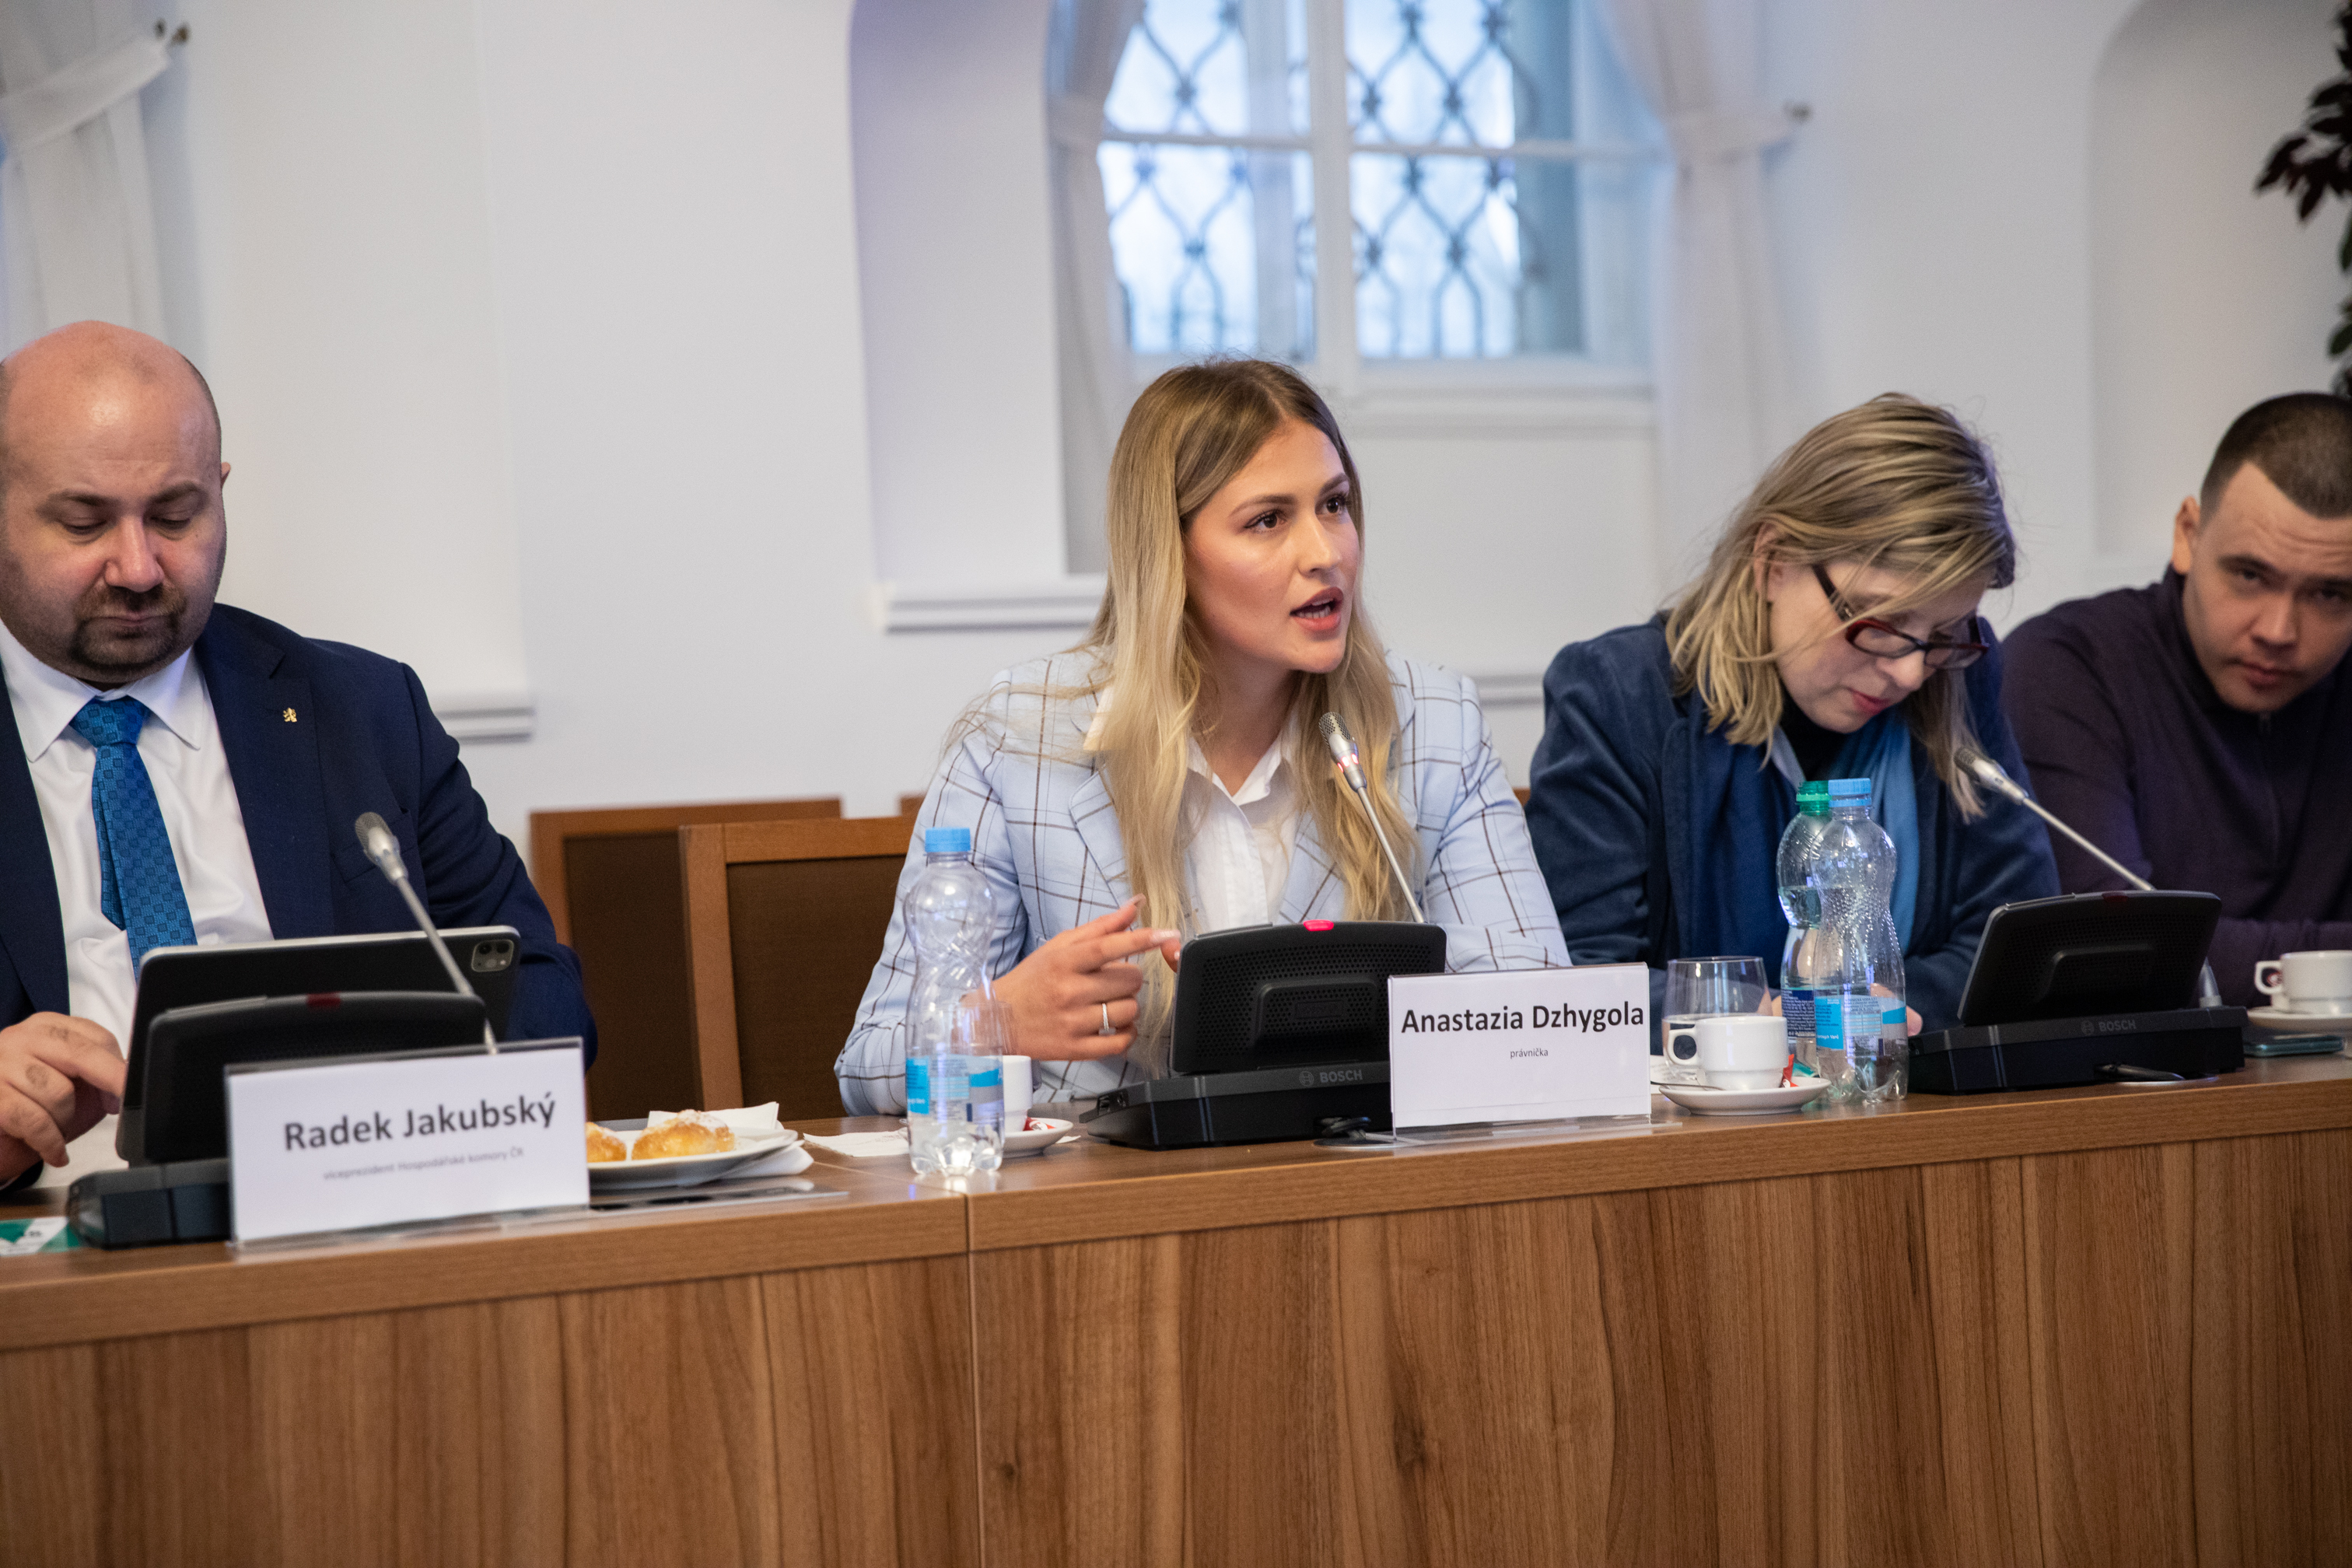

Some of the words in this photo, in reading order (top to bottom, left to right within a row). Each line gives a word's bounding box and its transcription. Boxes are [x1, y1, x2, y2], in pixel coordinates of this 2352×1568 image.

[1401, 1005, 1524, 1034] Anastazia
[1532, 1000, 1644, 1033] Dzhygola
[2098, 1019, 2137, 1032] BOSCH
[1510, 1047, 1549, 1059] právnička
[1320, 1069, 1363, 1083] BOSCH
[284, 1111, 393, 1150] Radek
[403, 1091, 555, 1138] Jakubský
[324, 1163, 395, 1180] viceprezident
[397, 1156, 465, 1171] Hospodářské
[468, 1151, 508, 1164] komory
[510, 1146, 524, 1158] ČR
